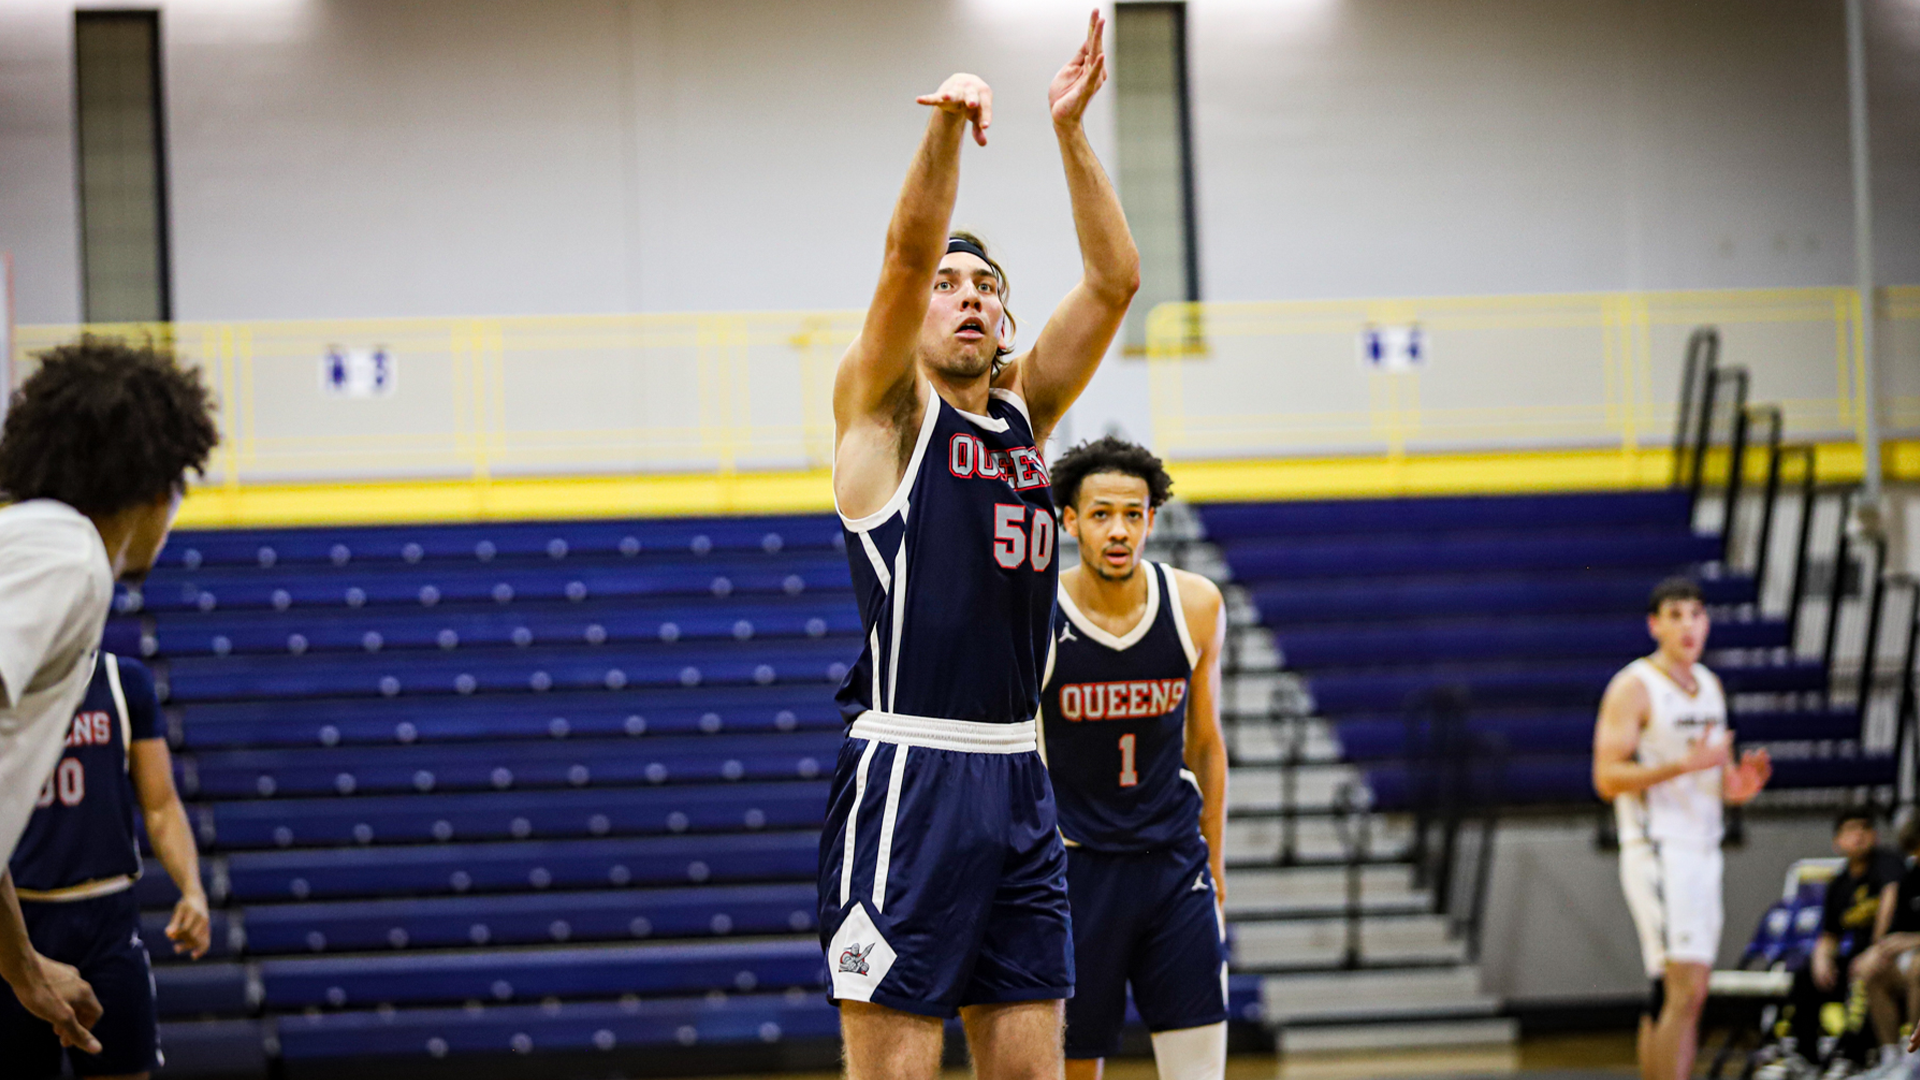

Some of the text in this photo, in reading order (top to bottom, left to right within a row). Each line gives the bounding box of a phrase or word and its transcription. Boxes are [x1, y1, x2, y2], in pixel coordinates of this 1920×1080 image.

[993, 503, 1054, 572] 50
[1059, 678, 1186, 721] QUEENS
[1118, 733, 1138, 787] 1
